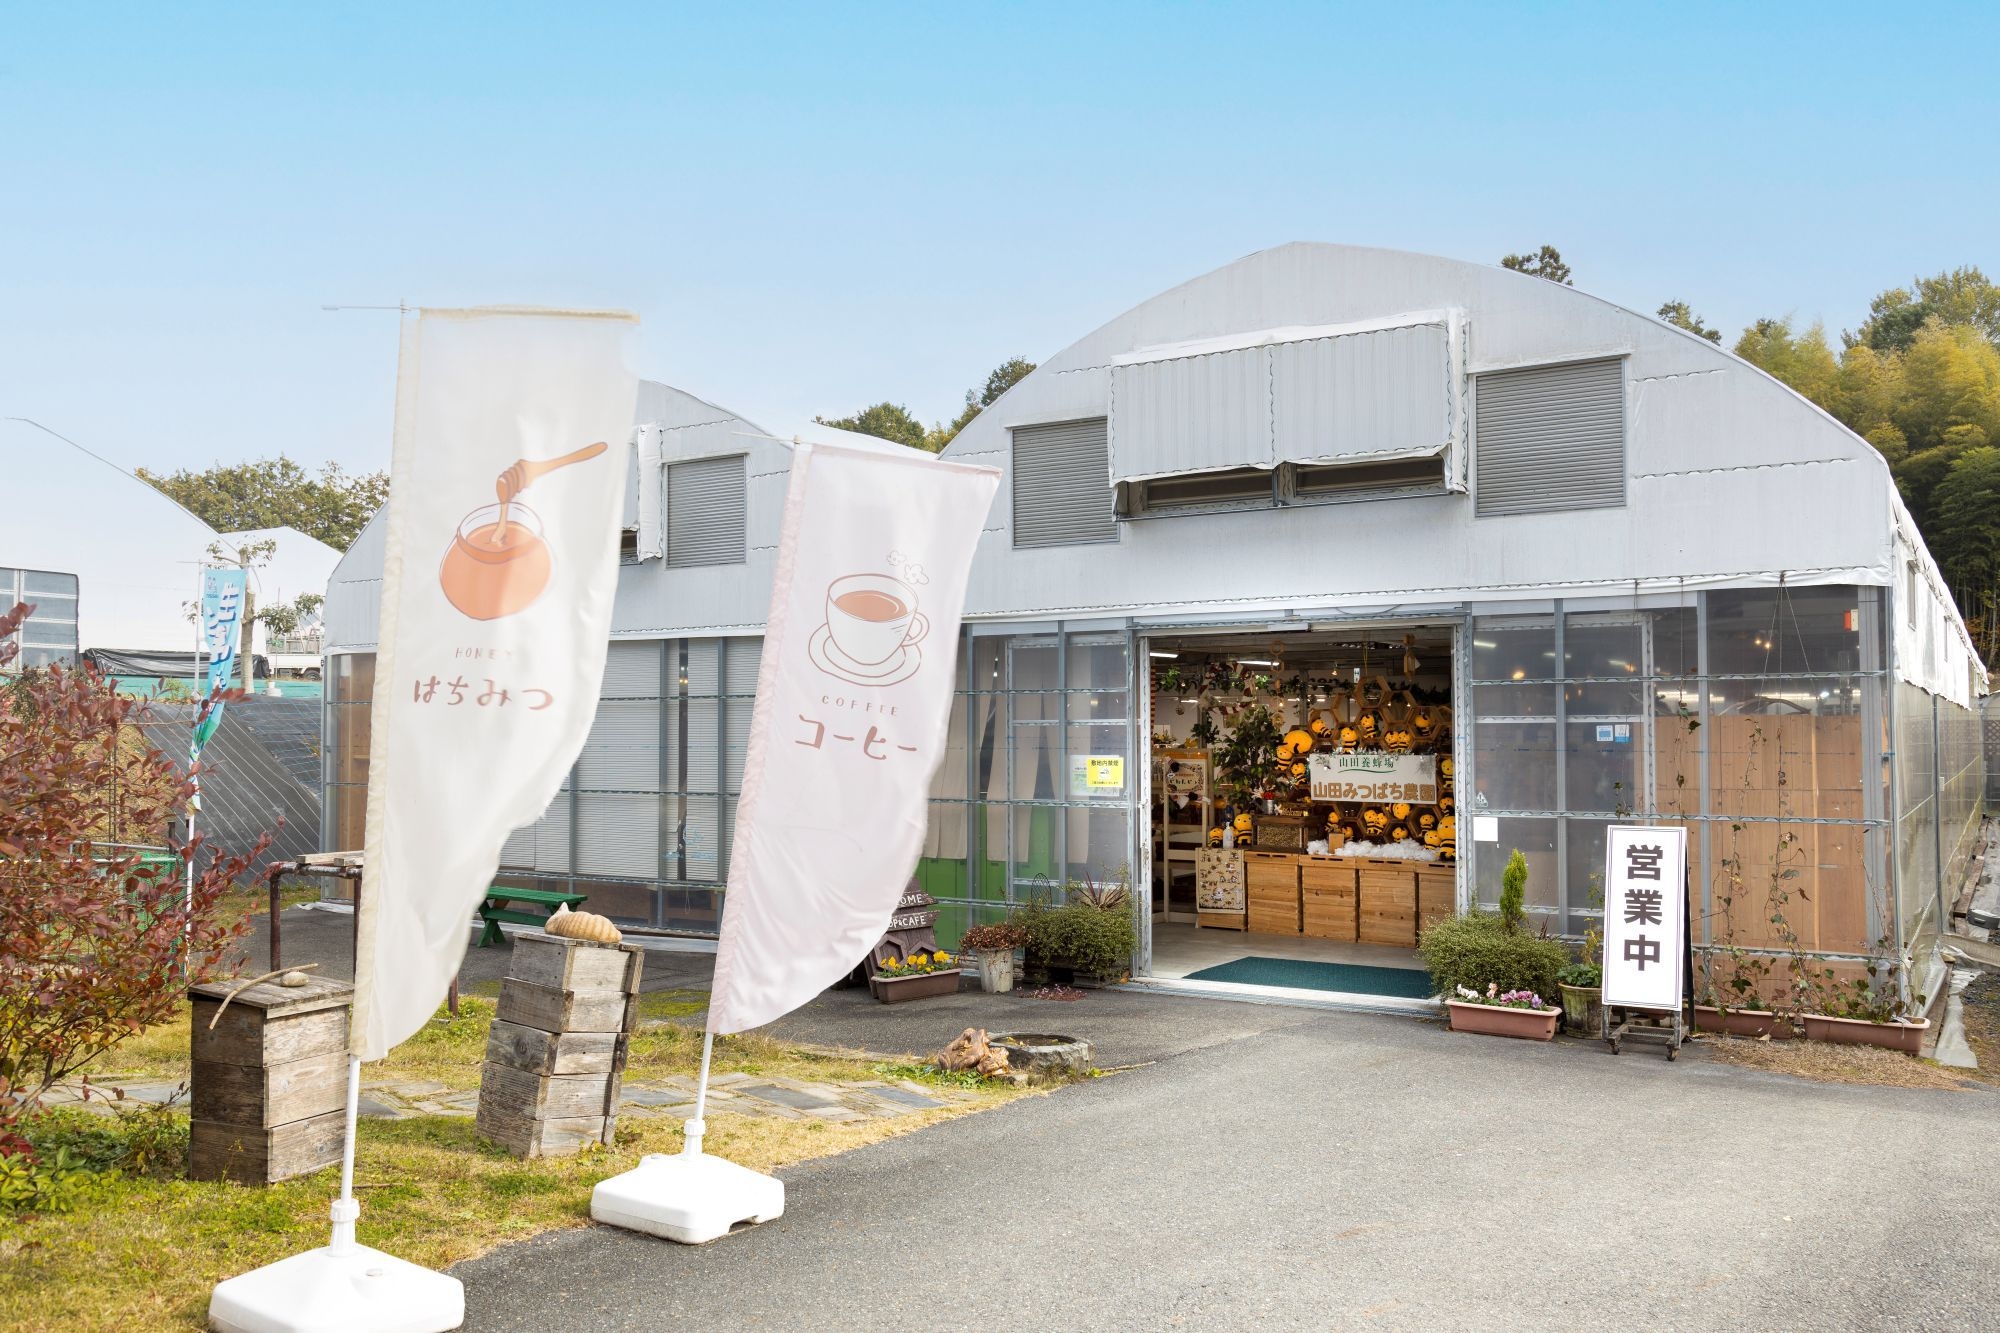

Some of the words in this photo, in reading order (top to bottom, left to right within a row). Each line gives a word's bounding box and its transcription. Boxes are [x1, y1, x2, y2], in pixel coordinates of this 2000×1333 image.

[414, 675, 554, 710] はちみつ
[822, 695, 898, 716] COFFEE
[795, 714, 917, 760] コーヒー
[1313, 782, 1436, 802] 山田みつばち農園
[1624, 844, 1663, 971] 営業中
